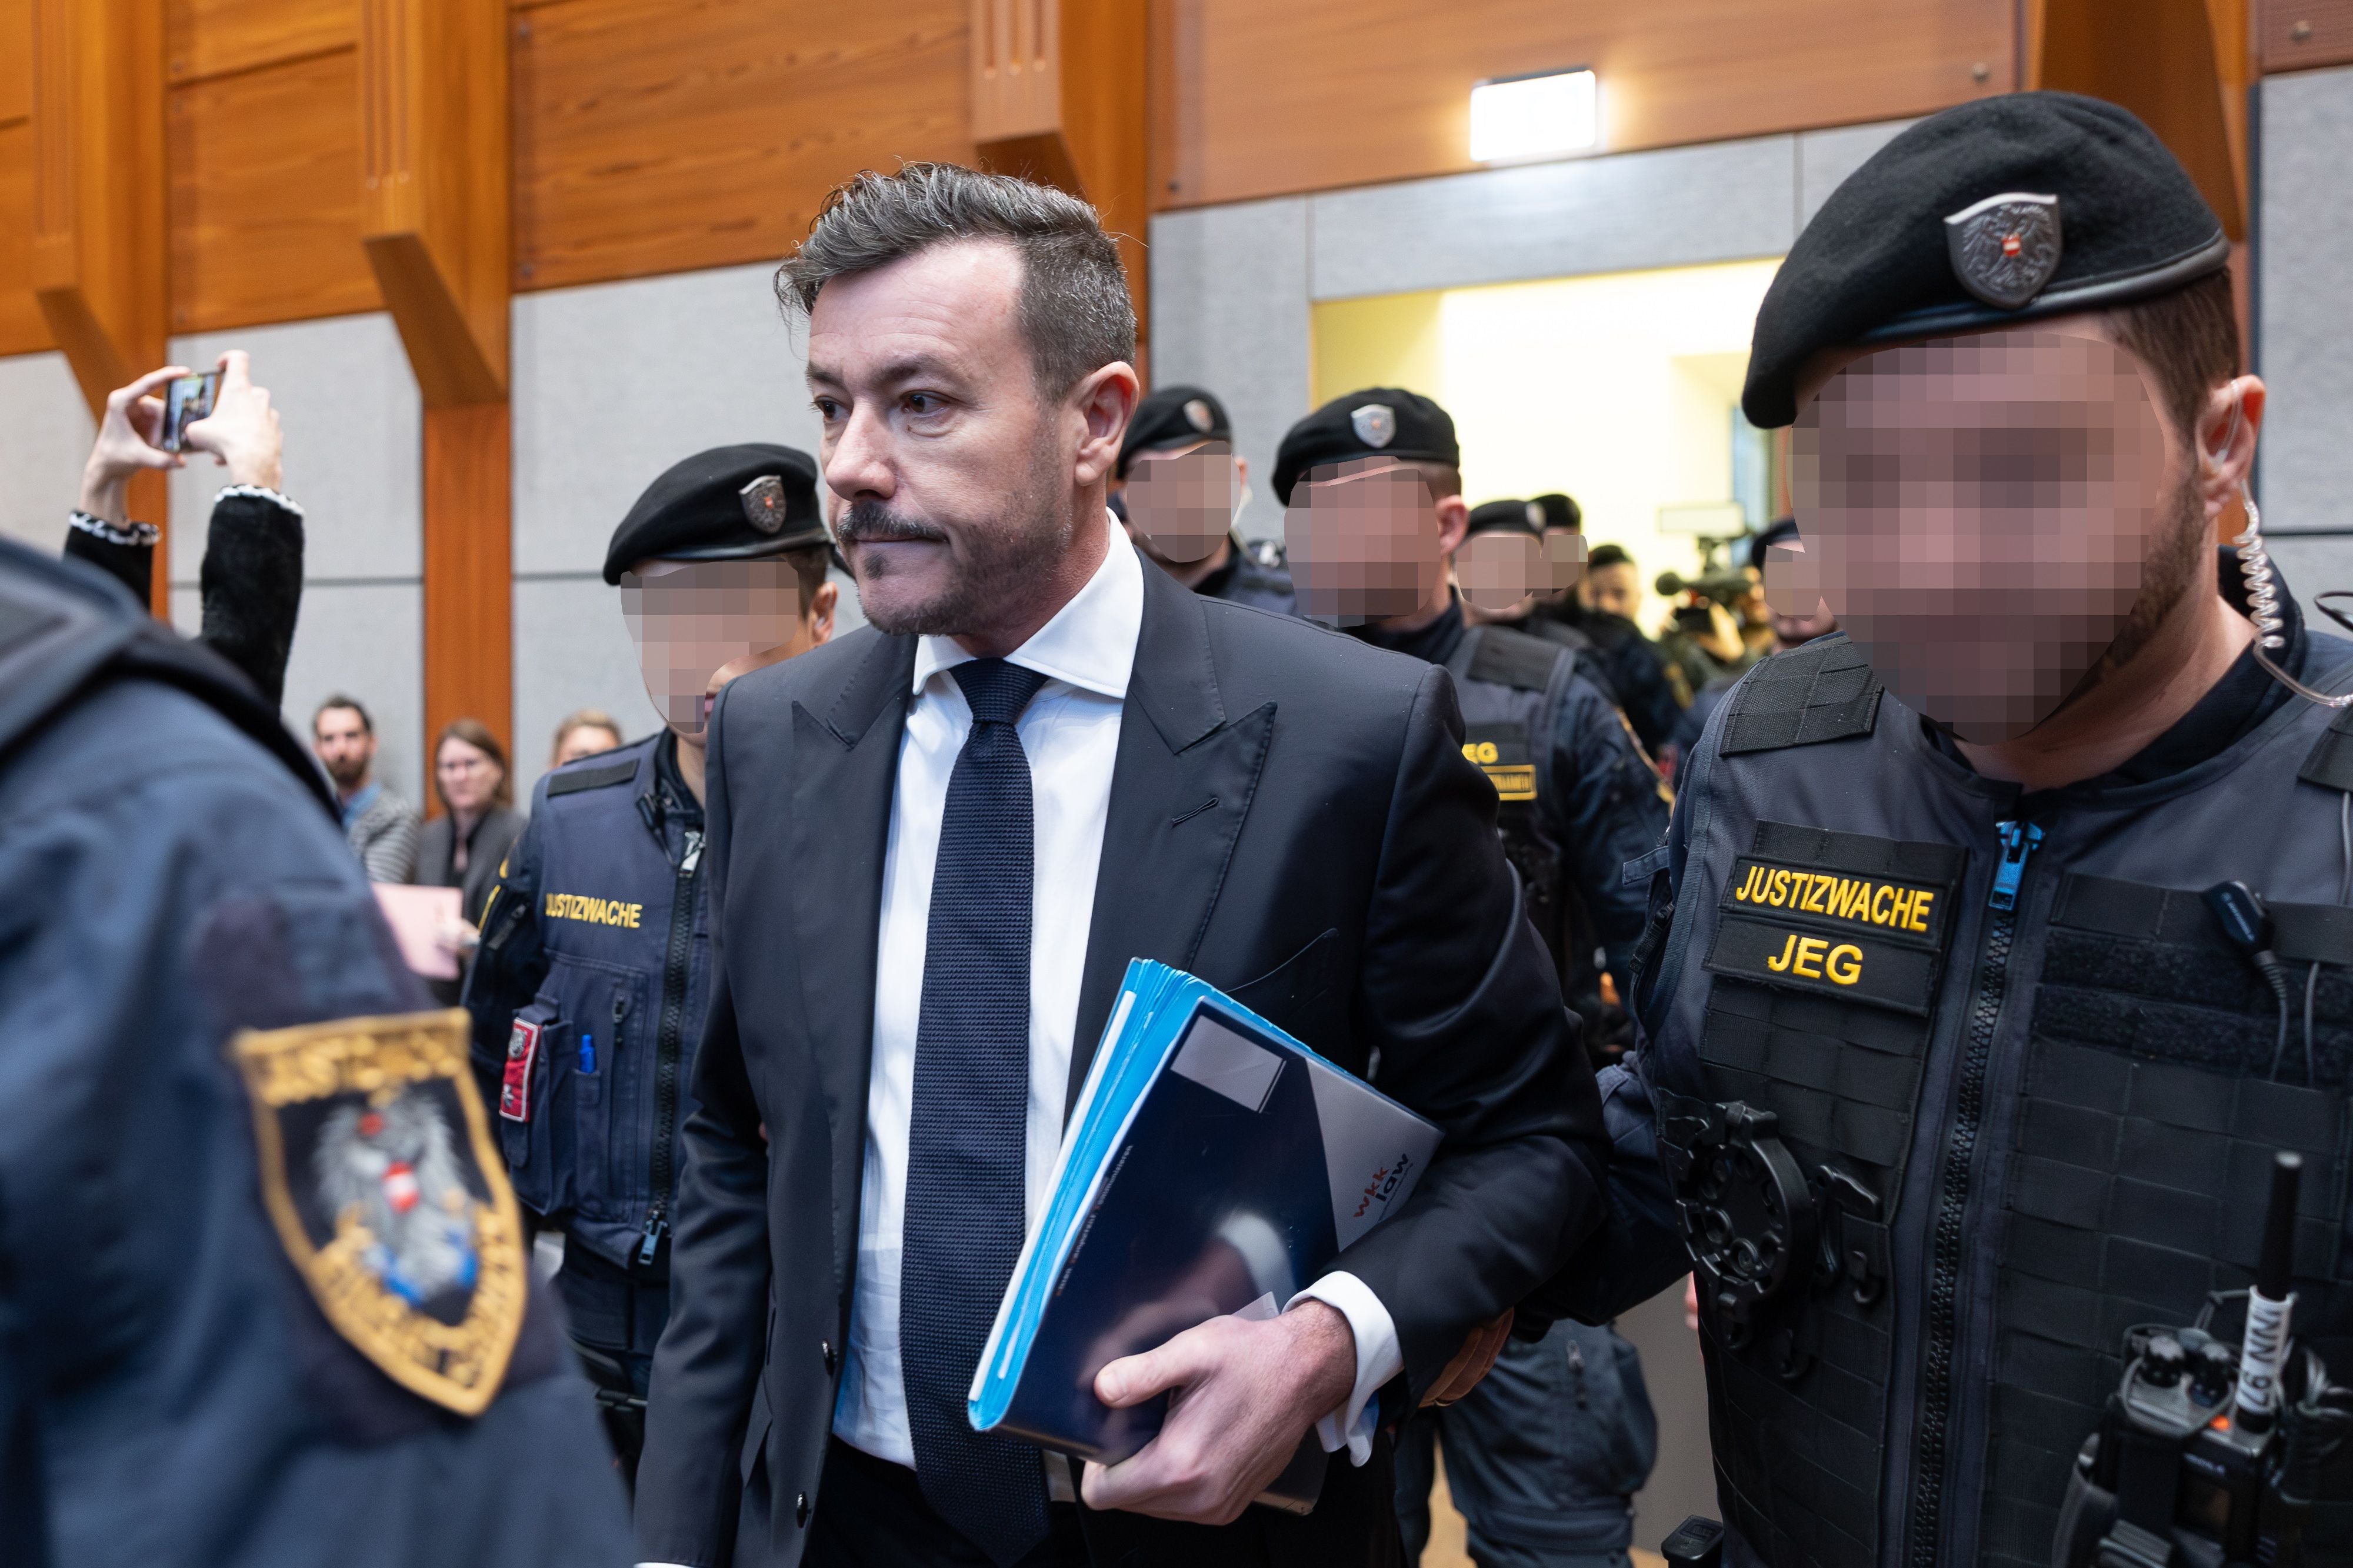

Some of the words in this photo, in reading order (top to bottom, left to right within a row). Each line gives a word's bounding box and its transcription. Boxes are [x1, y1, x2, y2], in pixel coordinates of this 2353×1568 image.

[1461, 742, 1499, 764] EG
[1736, 866, 1934, 932] JUSTIZWACHE
[1768, 935, 1864, 985] JEG
[1354, 1167, 1389, 1217] wkk
[1375, 1153, 1409, 1202] law
